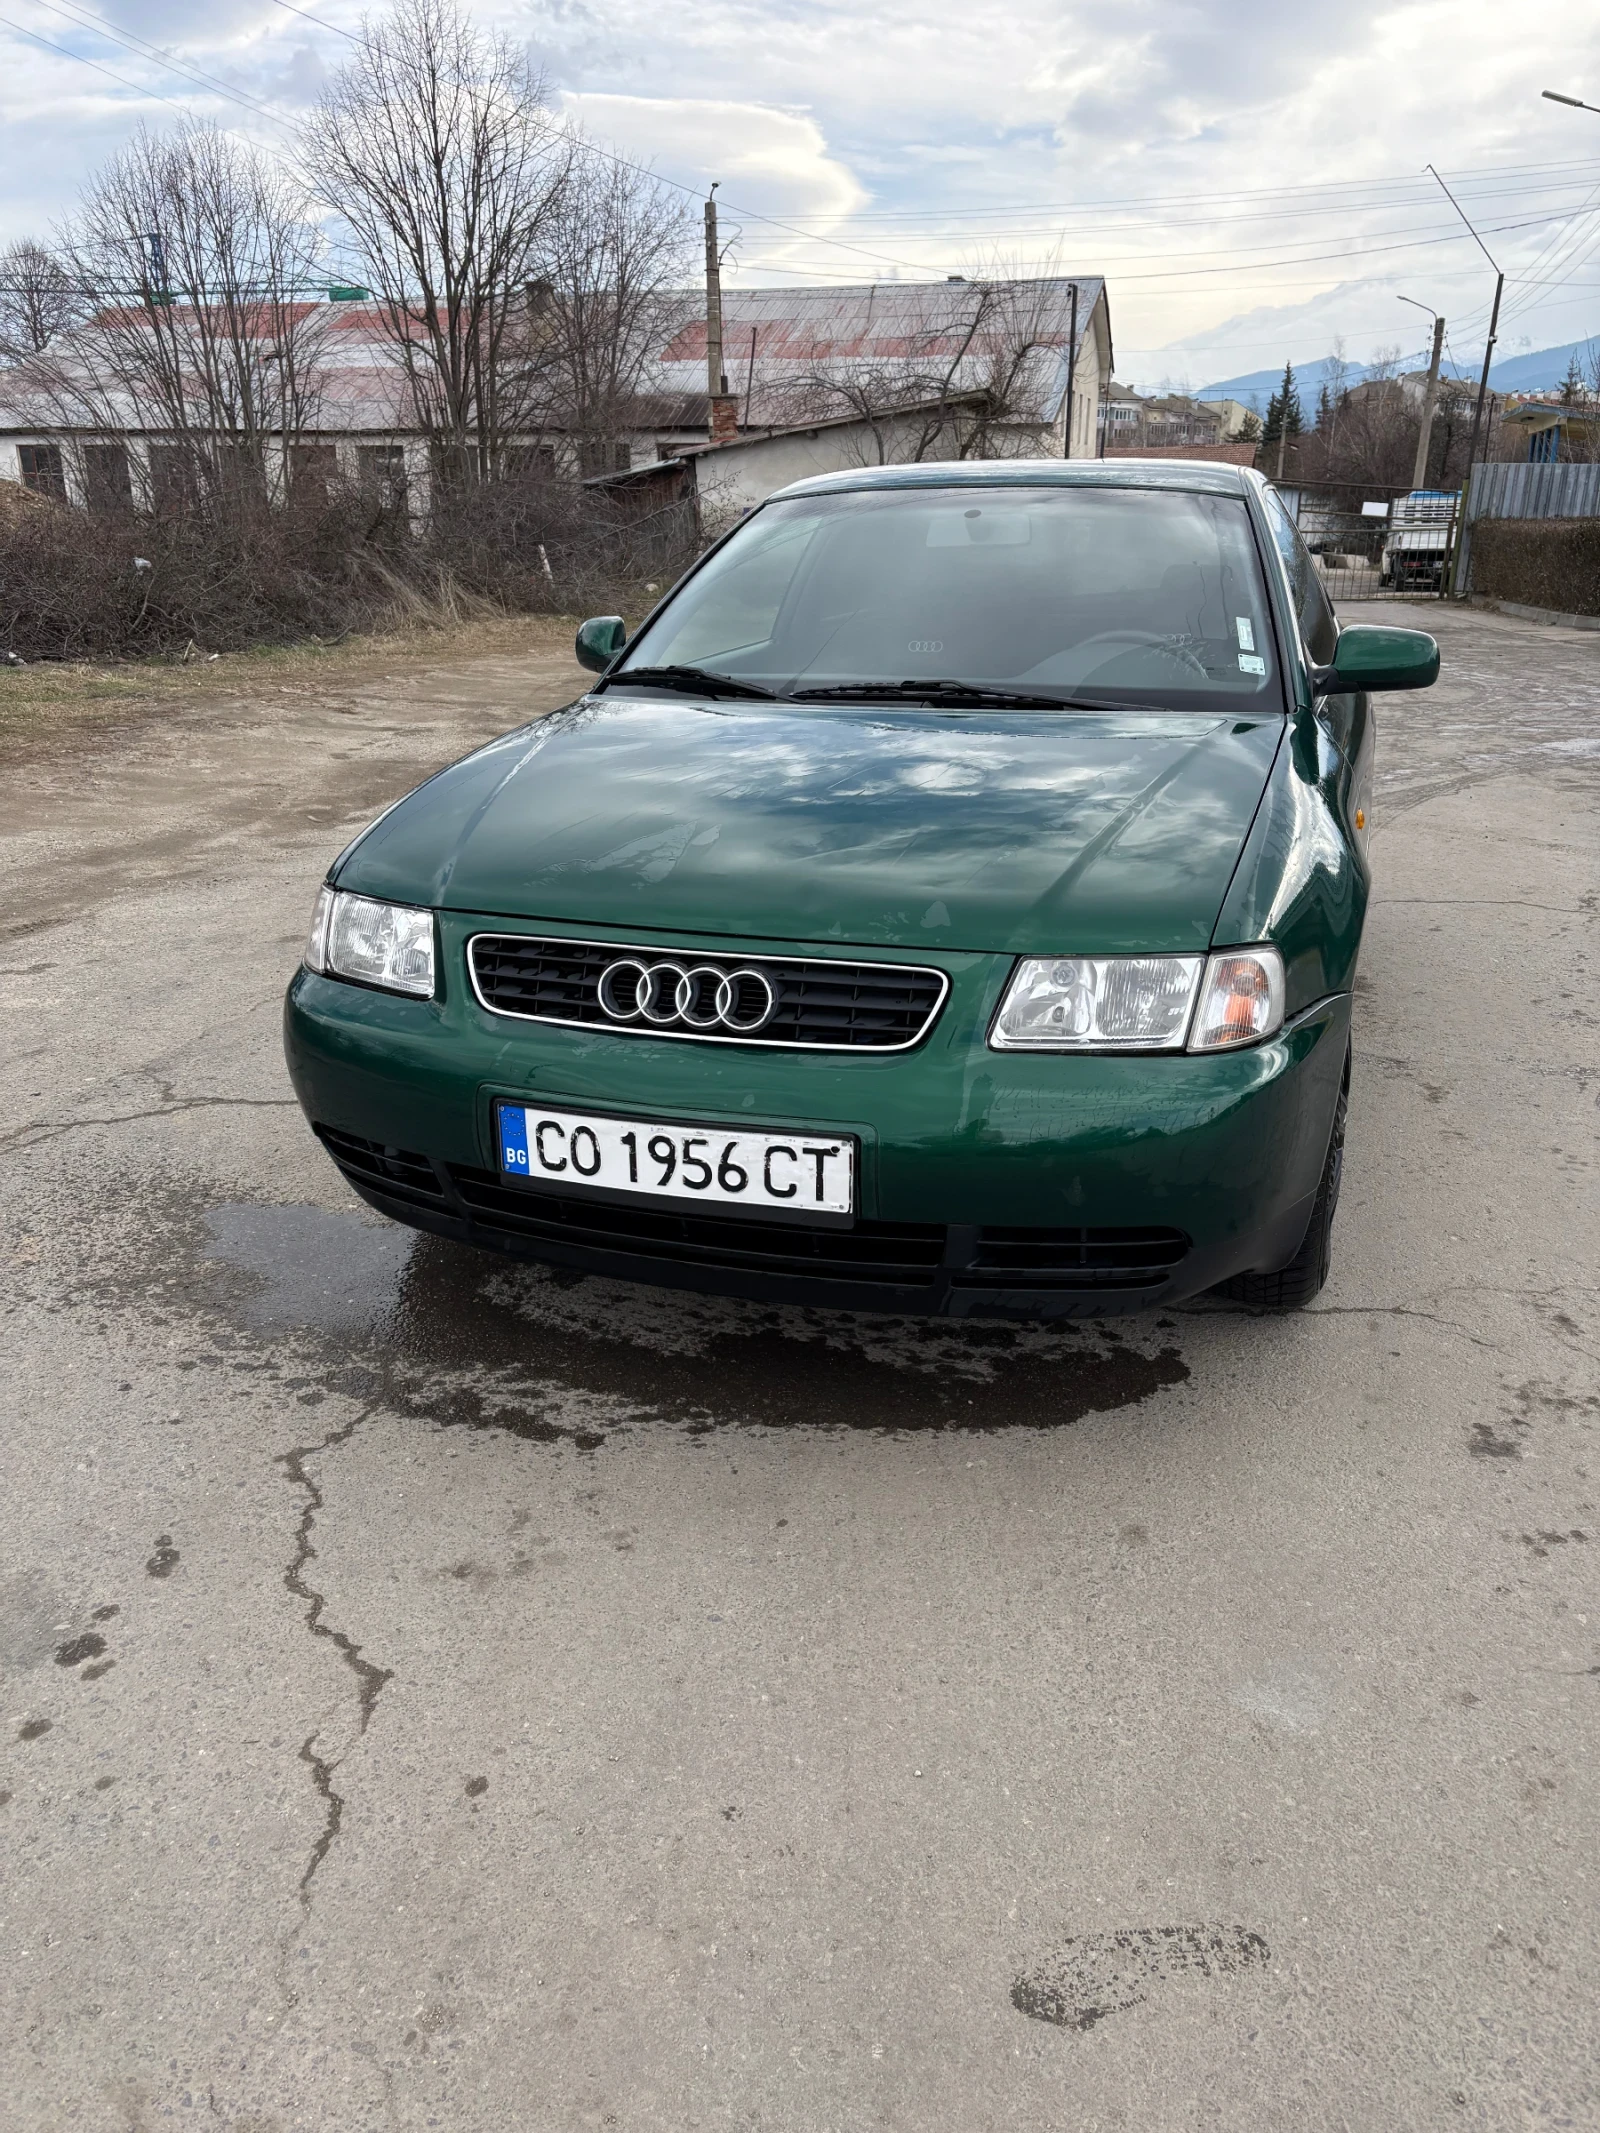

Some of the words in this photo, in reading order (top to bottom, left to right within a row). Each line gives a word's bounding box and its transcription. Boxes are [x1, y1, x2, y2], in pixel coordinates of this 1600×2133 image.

[505, 1147, 527, 1165] BG
[535, 1120, 602, 1177] CO
[620, 1131, 749, 1192] 1956
[763, 1145, 838, 1202] CT
